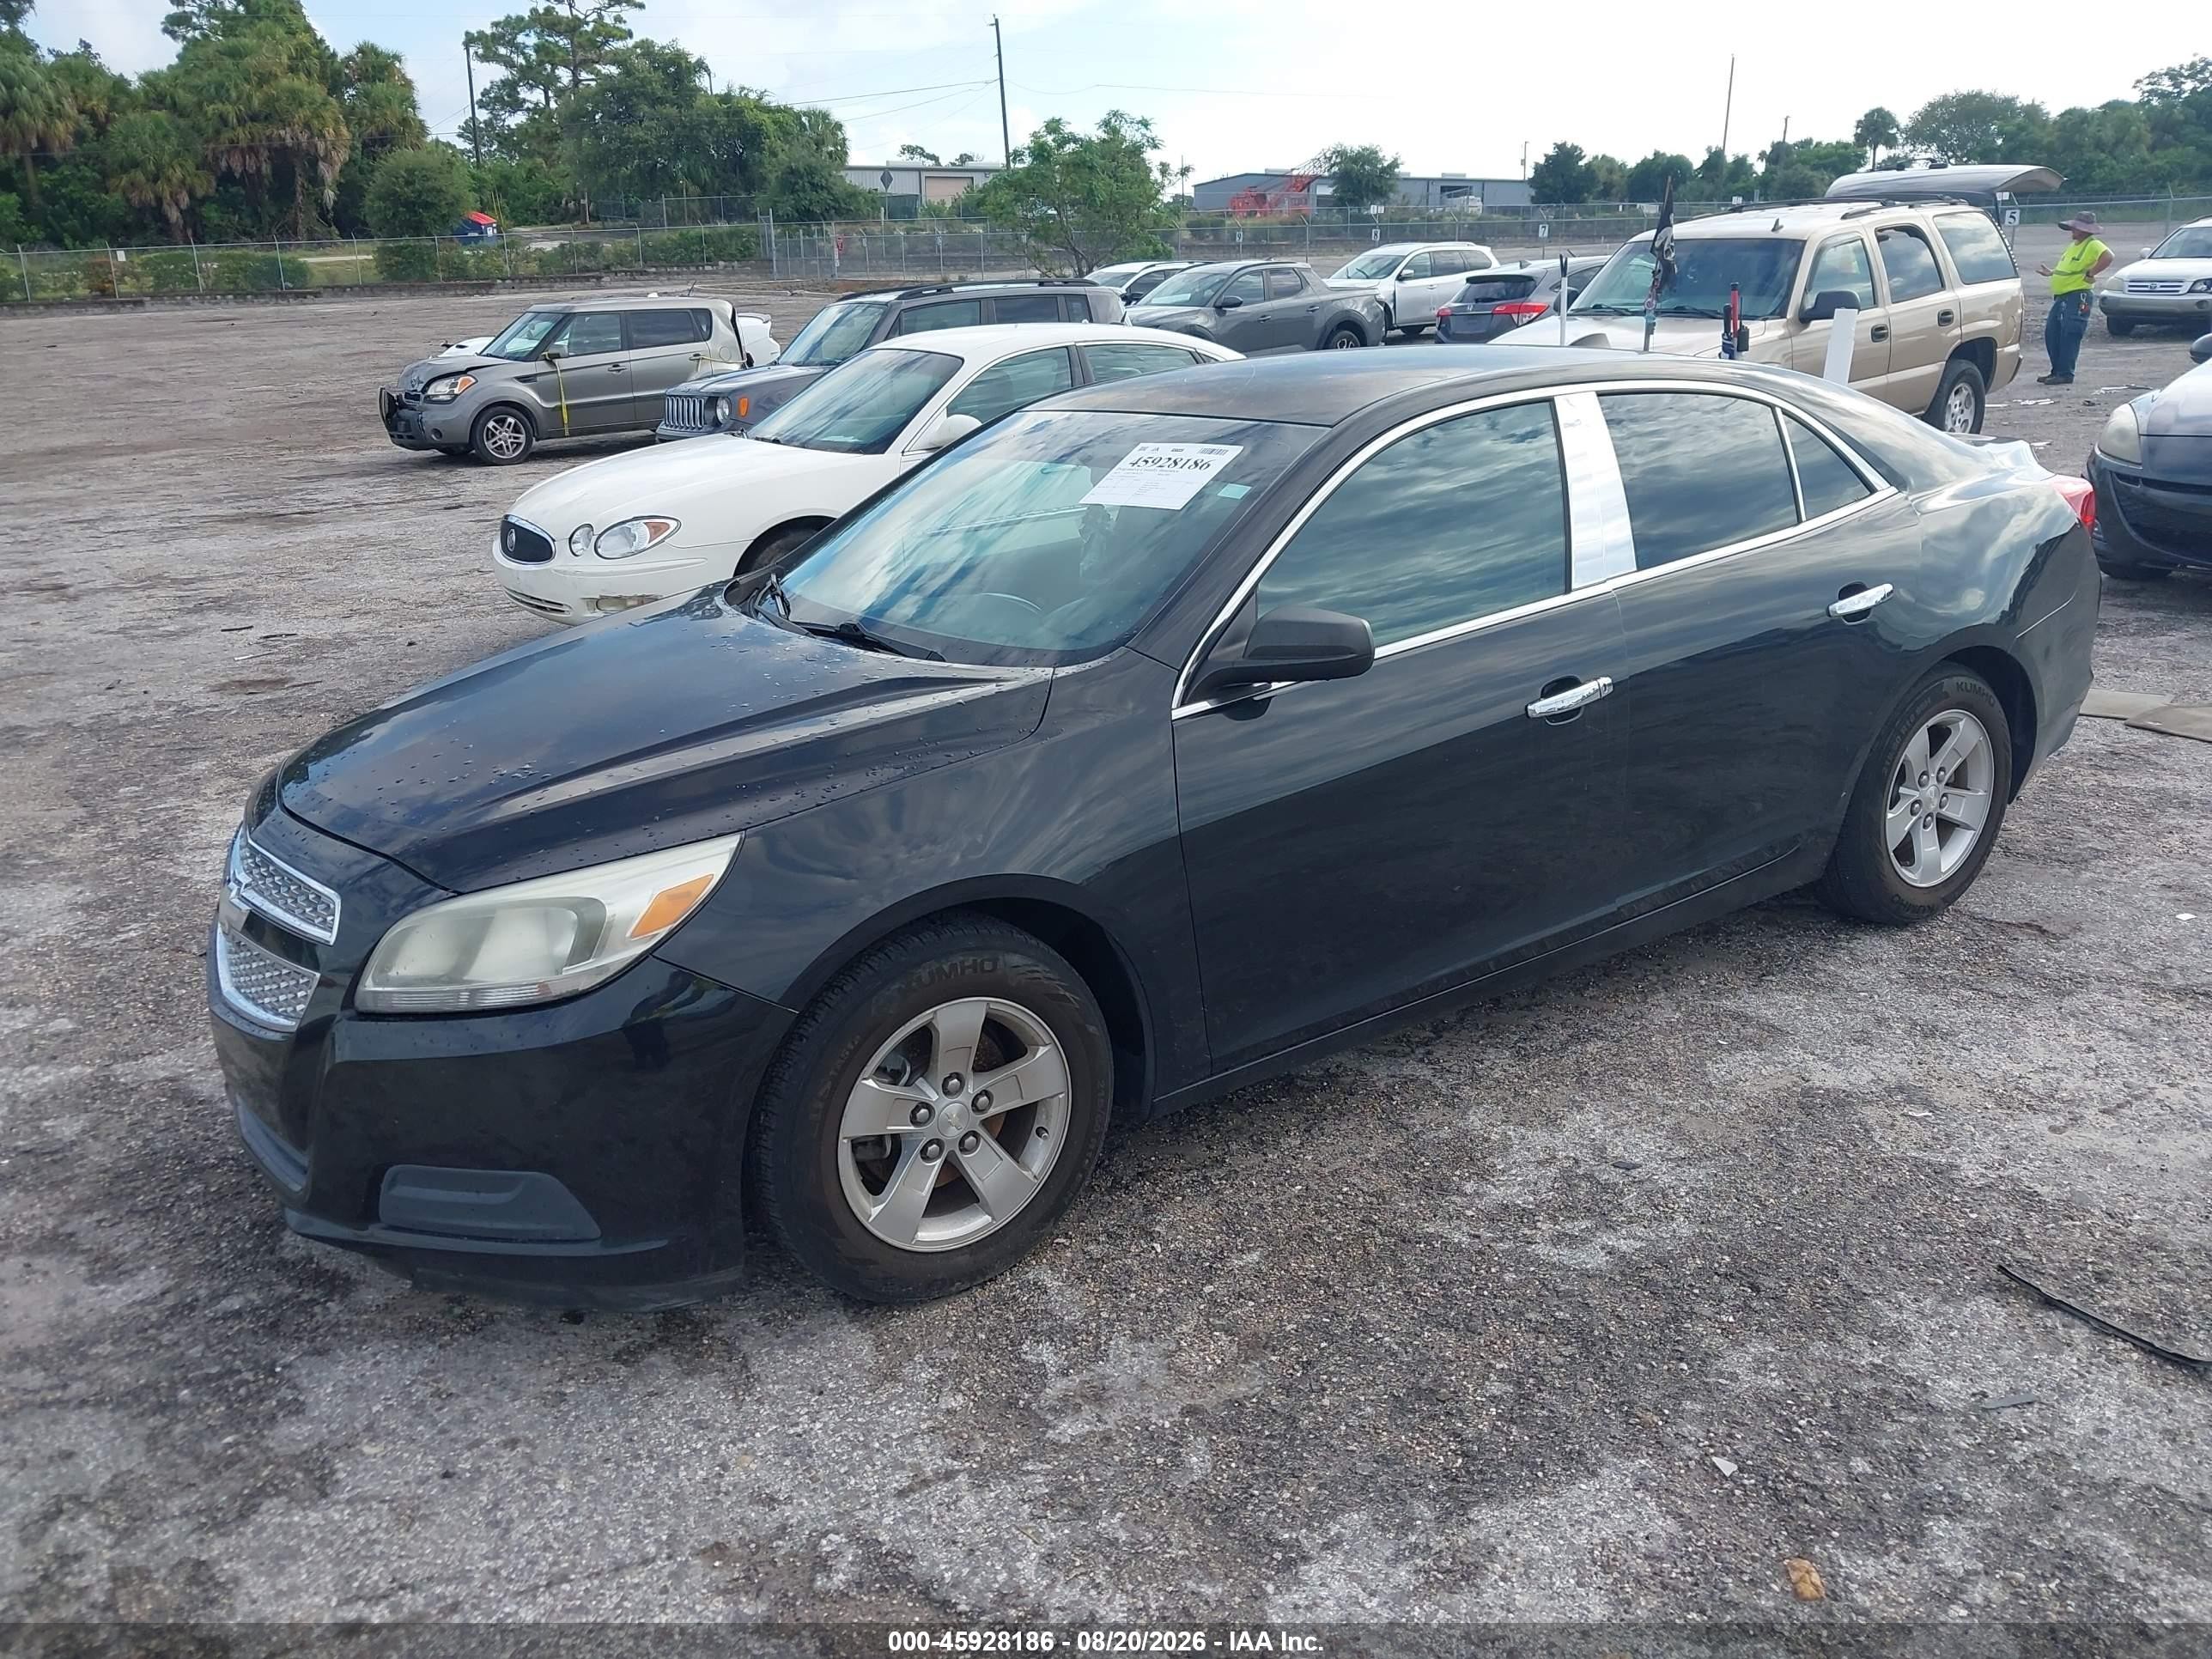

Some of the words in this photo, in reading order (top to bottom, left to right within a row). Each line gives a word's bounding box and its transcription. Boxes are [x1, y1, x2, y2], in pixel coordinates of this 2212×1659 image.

[2008, 211, 2017, 224] 5
[1373, 230, 1378, 240] 8
[1540, 225, 1547, 236] 7
[1237, 233, 1242, 241] 9
[1129, 456, 1216, 471] 45928186
[1955, 681, 1996, 708] KUMHO
